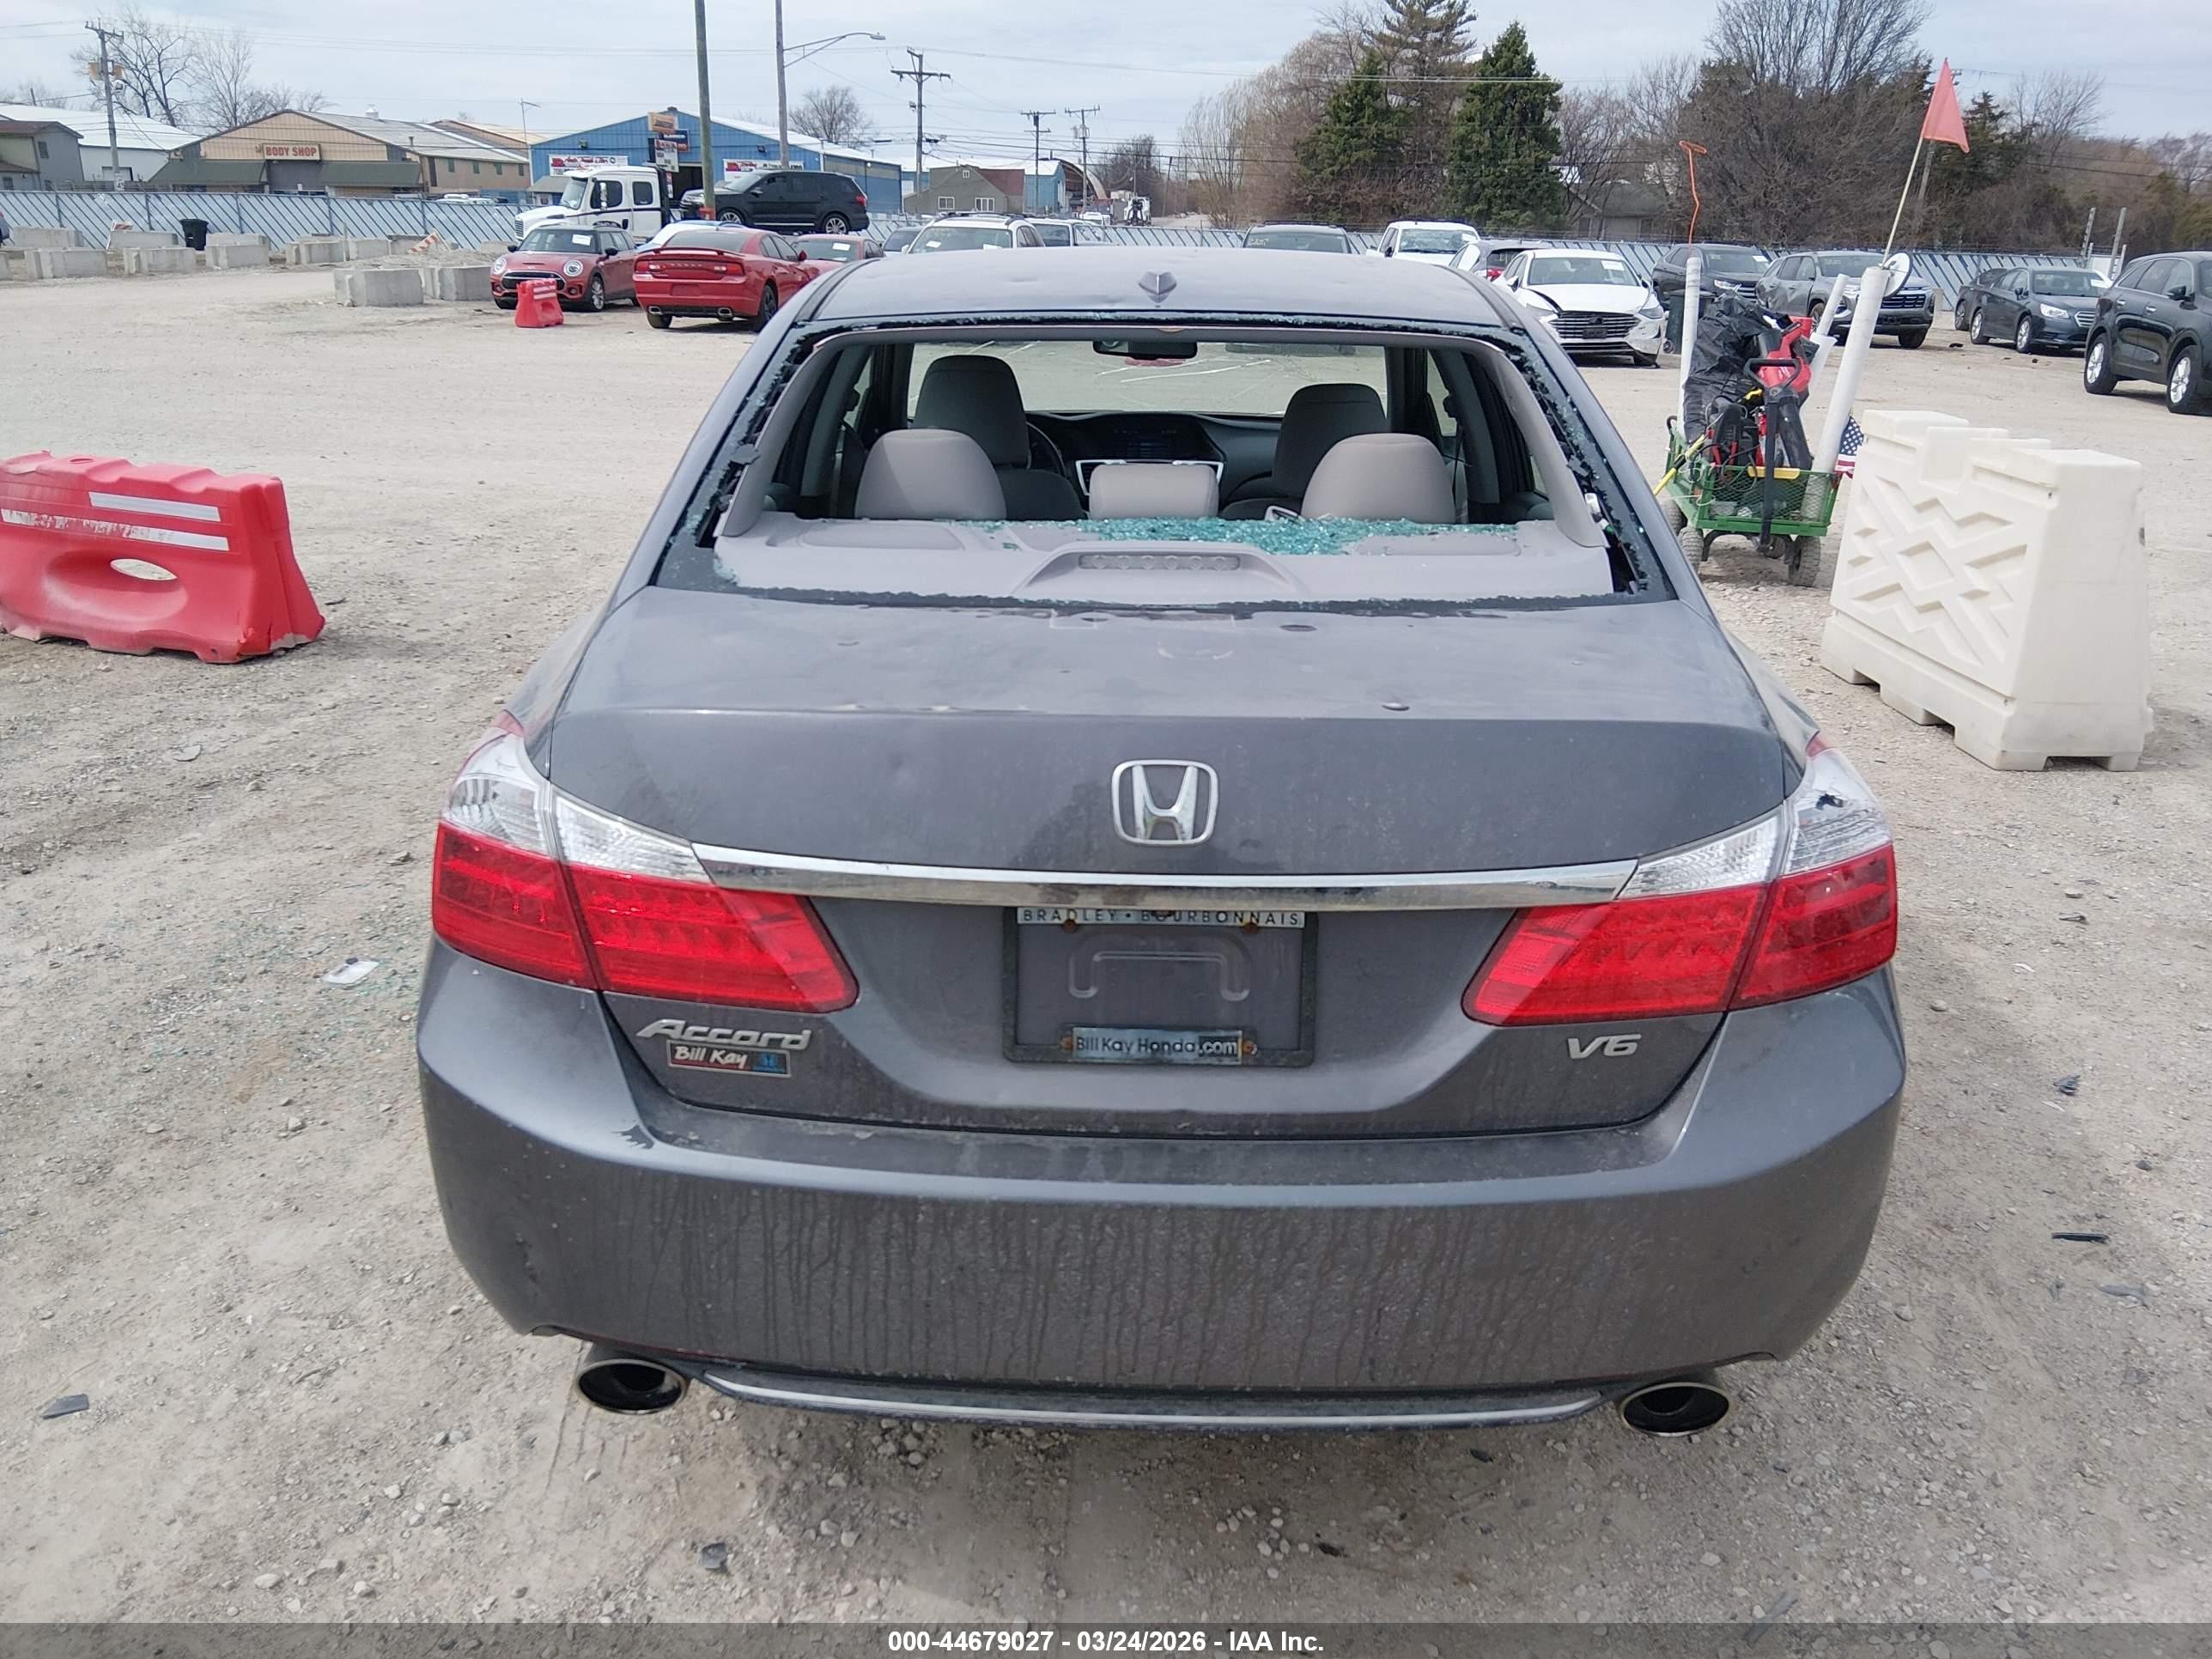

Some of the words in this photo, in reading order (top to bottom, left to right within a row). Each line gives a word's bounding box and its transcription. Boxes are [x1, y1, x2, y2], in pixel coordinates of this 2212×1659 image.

[265, 146, 290, 156] BODY
[292, 146, 317, 157] SHOP
[1023, 908, 1117, 921] BRADLEY
[1140, 909, 1298, 926] BOURBONNAIS
[636, 1018, 811, 1050] Accord
[1567, 1033, 1642, 1059] V6
[674, 1046, 705, 1062] Bill
[709, 1049, 748, 1070] Kay
